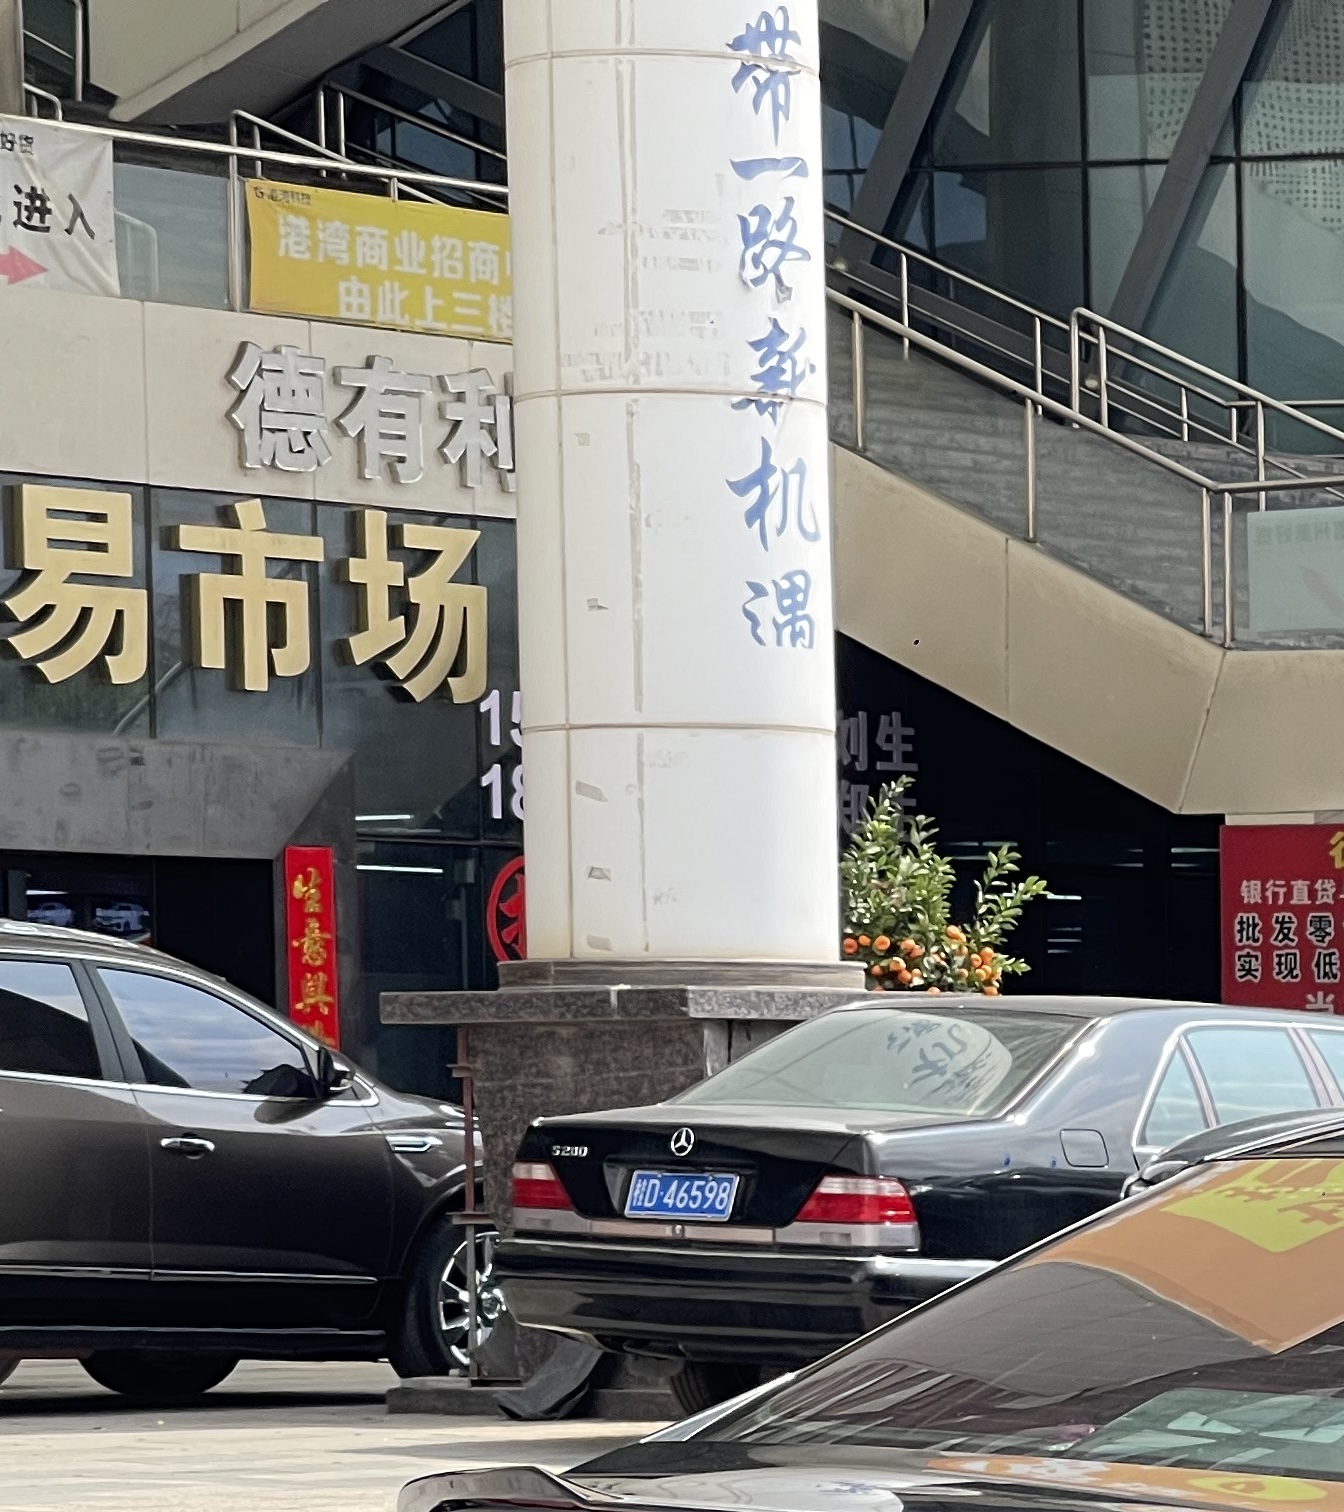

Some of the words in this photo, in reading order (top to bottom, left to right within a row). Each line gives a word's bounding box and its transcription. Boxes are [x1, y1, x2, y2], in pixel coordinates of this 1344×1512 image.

[278, 212, 512, 286] 港湾商业招商
